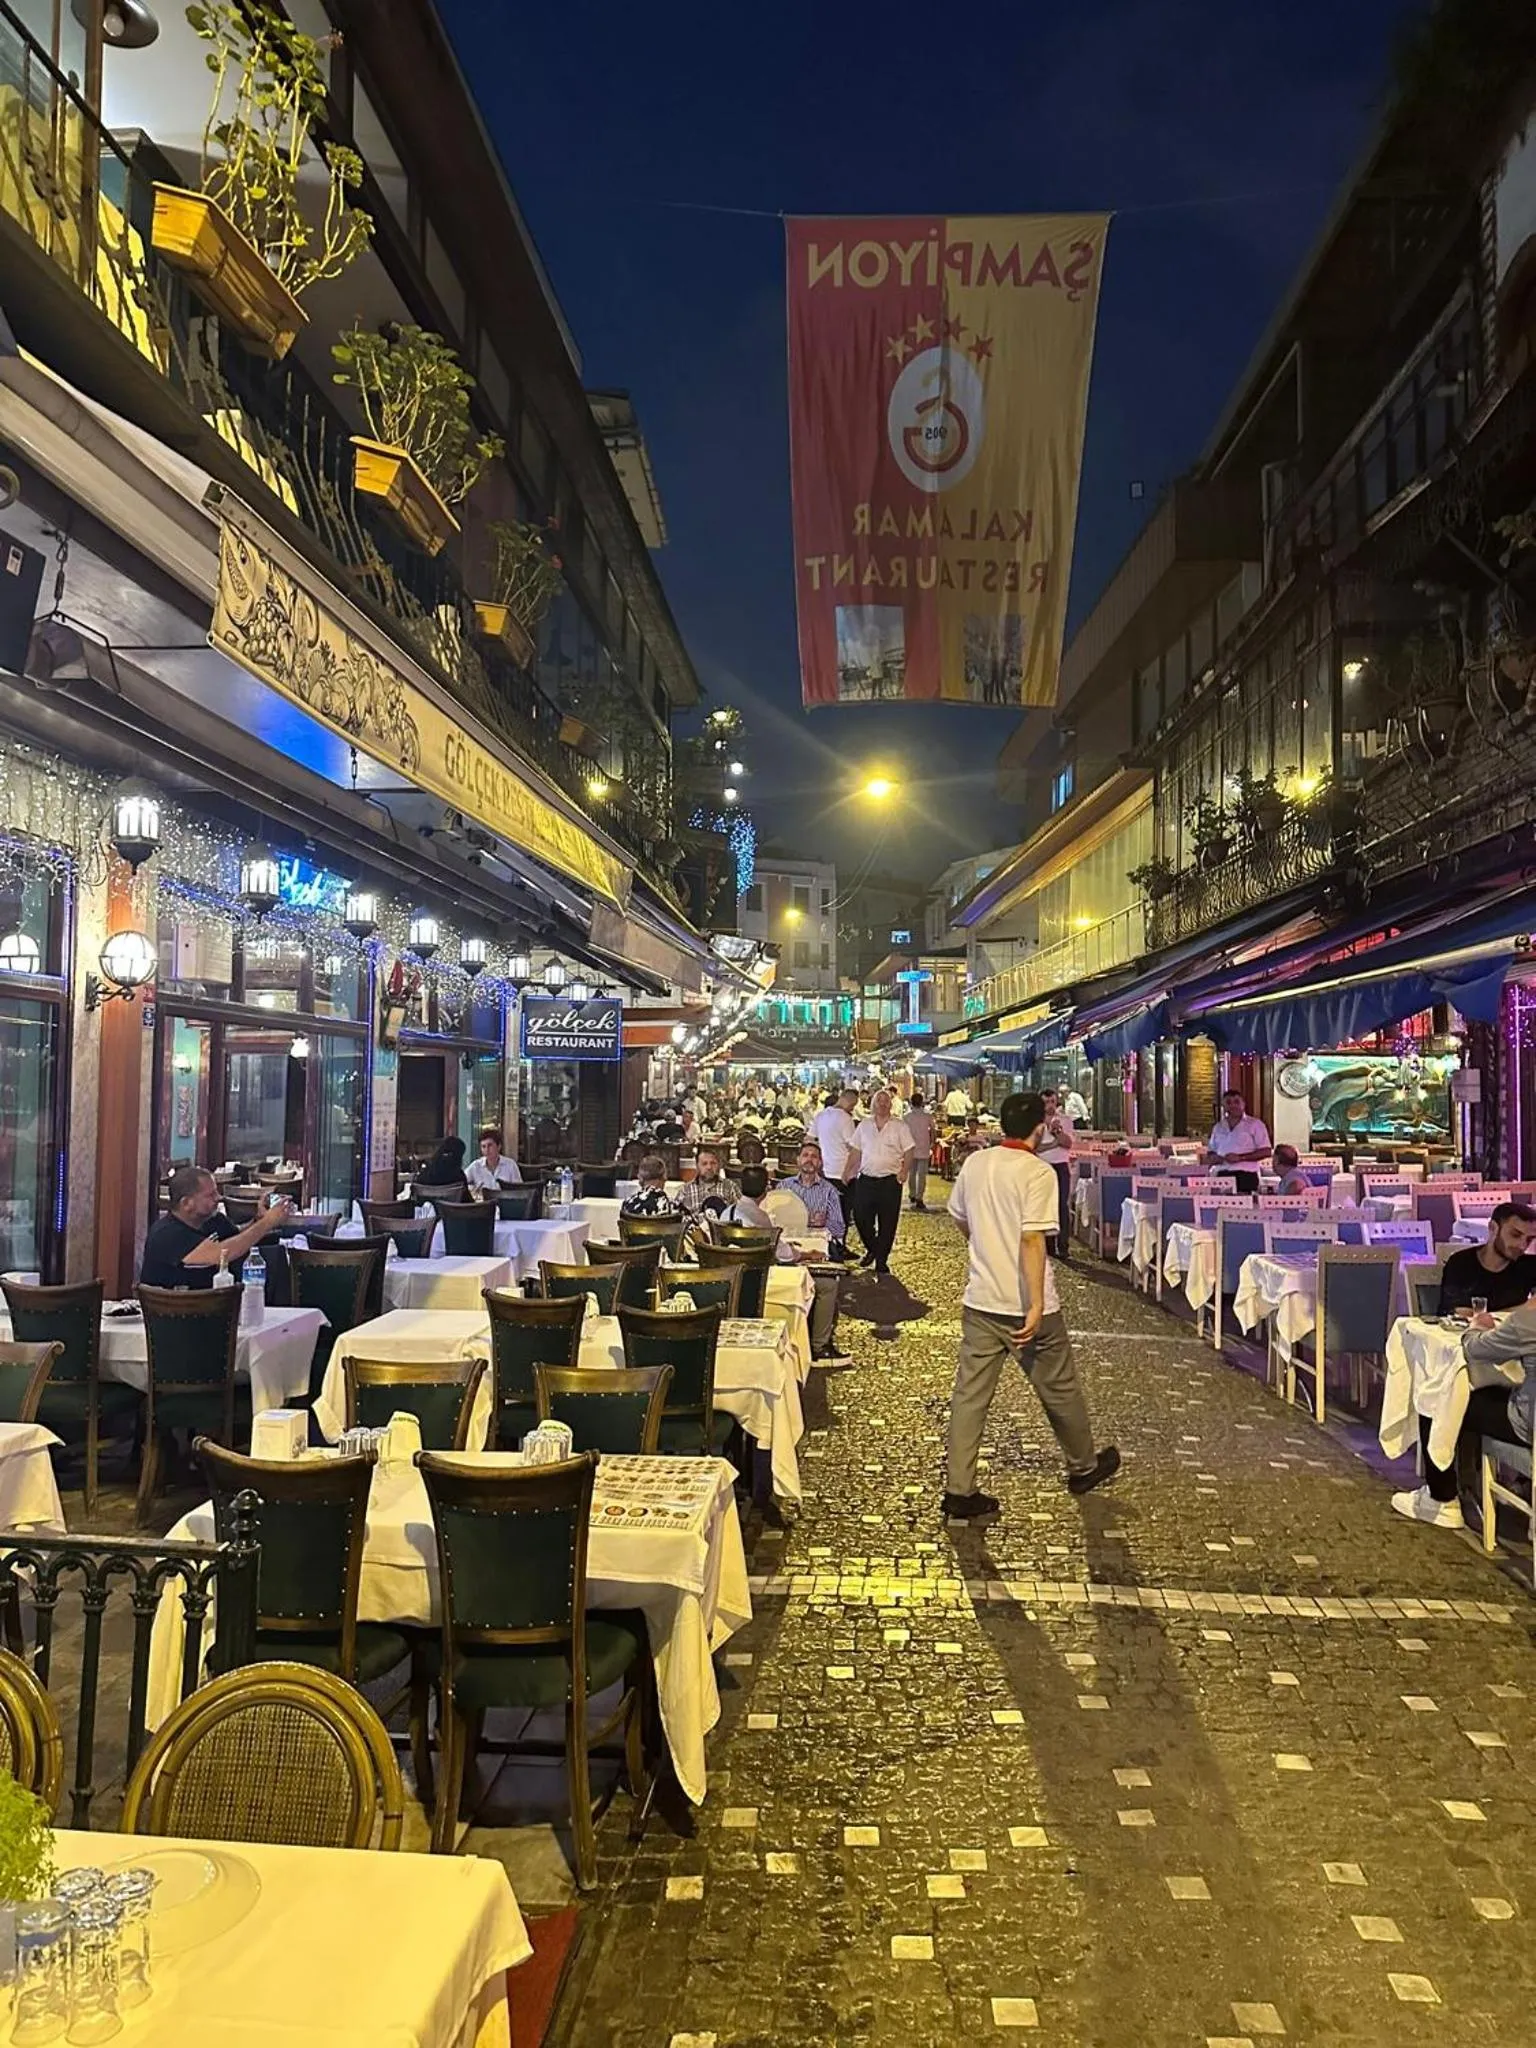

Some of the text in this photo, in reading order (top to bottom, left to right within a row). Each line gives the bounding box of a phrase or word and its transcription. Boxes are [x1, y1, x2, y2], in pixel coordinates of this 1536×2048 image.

[445, 732, 501, 810] GÖLÇEK
[526, 1009, 617, 1034] gölçek
[527, 1035, 615, 1048] RESTAURANT
